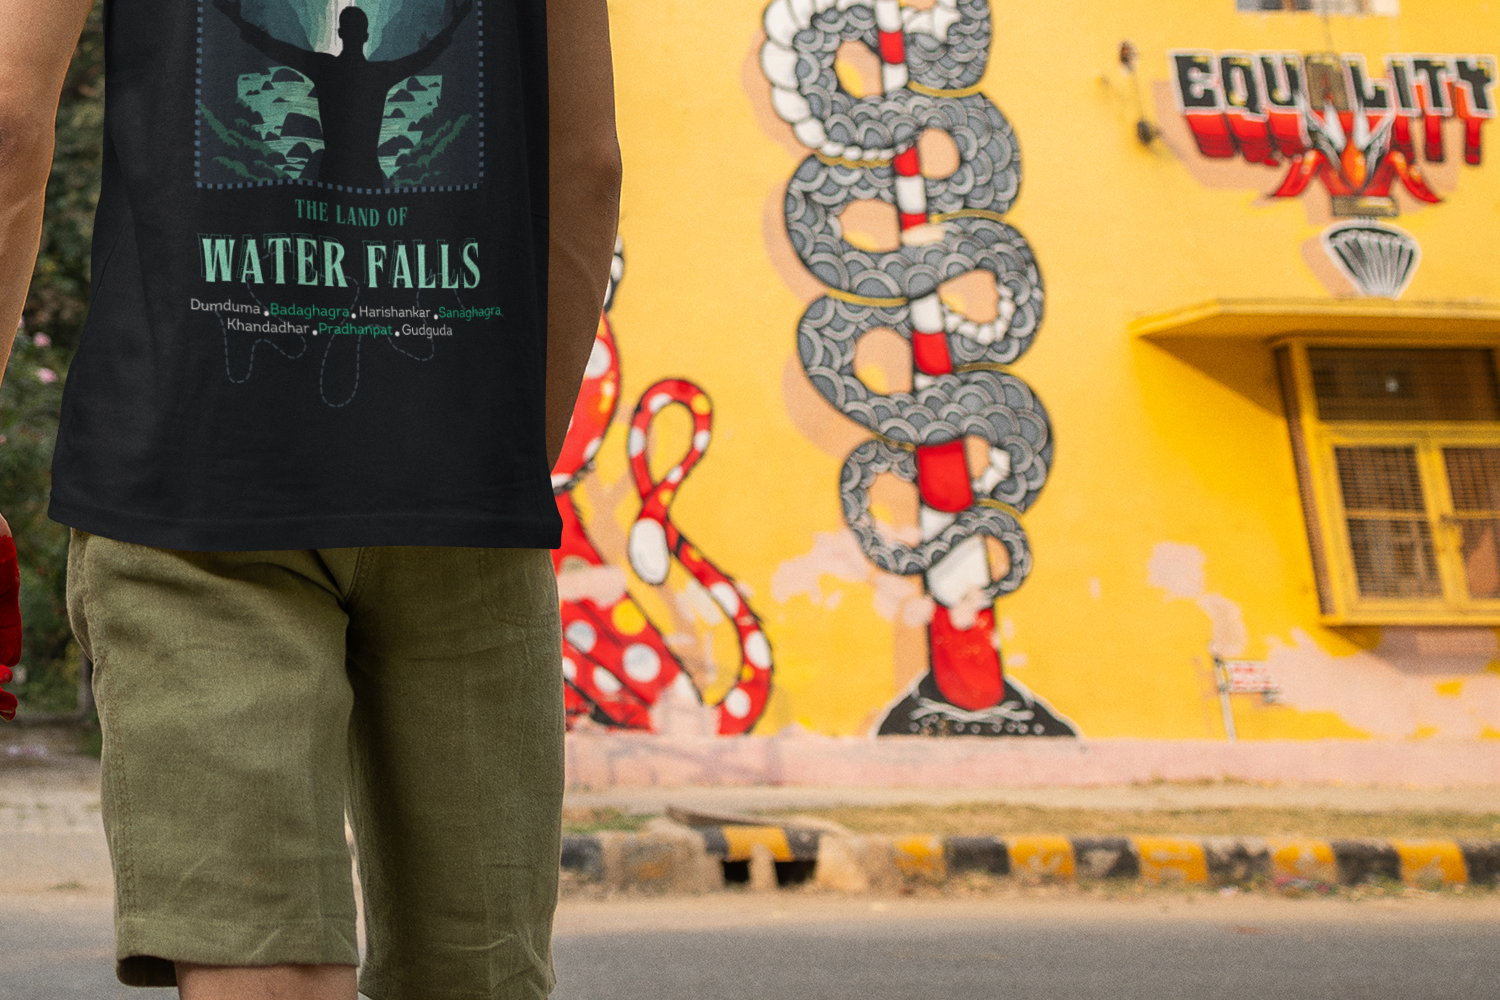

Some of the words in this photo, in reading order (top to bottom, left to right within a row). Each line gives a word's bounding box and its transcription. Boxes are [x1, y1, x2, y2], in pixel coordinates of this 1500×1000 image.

[1171, 50, 1496, 118] EQUALITY
[294, 198, 329, 221] THE
[336, 204, 380, 227] LAND
[387, 207, 408, 226] OF
[201, 237, 349, 288] WATER
[366, 241, 481, 289] FALLS
[190, 298, 261, 315] Dumduma
[270, 302, 350, 320] Badaghagra
[359, 305, 431, 318] Harishankar
[438, 306, 501, 322] Sanaghagra
[227, 317, 310, 334] Khandadhar
[318, 322, 393, 339] Pradhanpat
[401, 323, 453, 339] Gudguda
